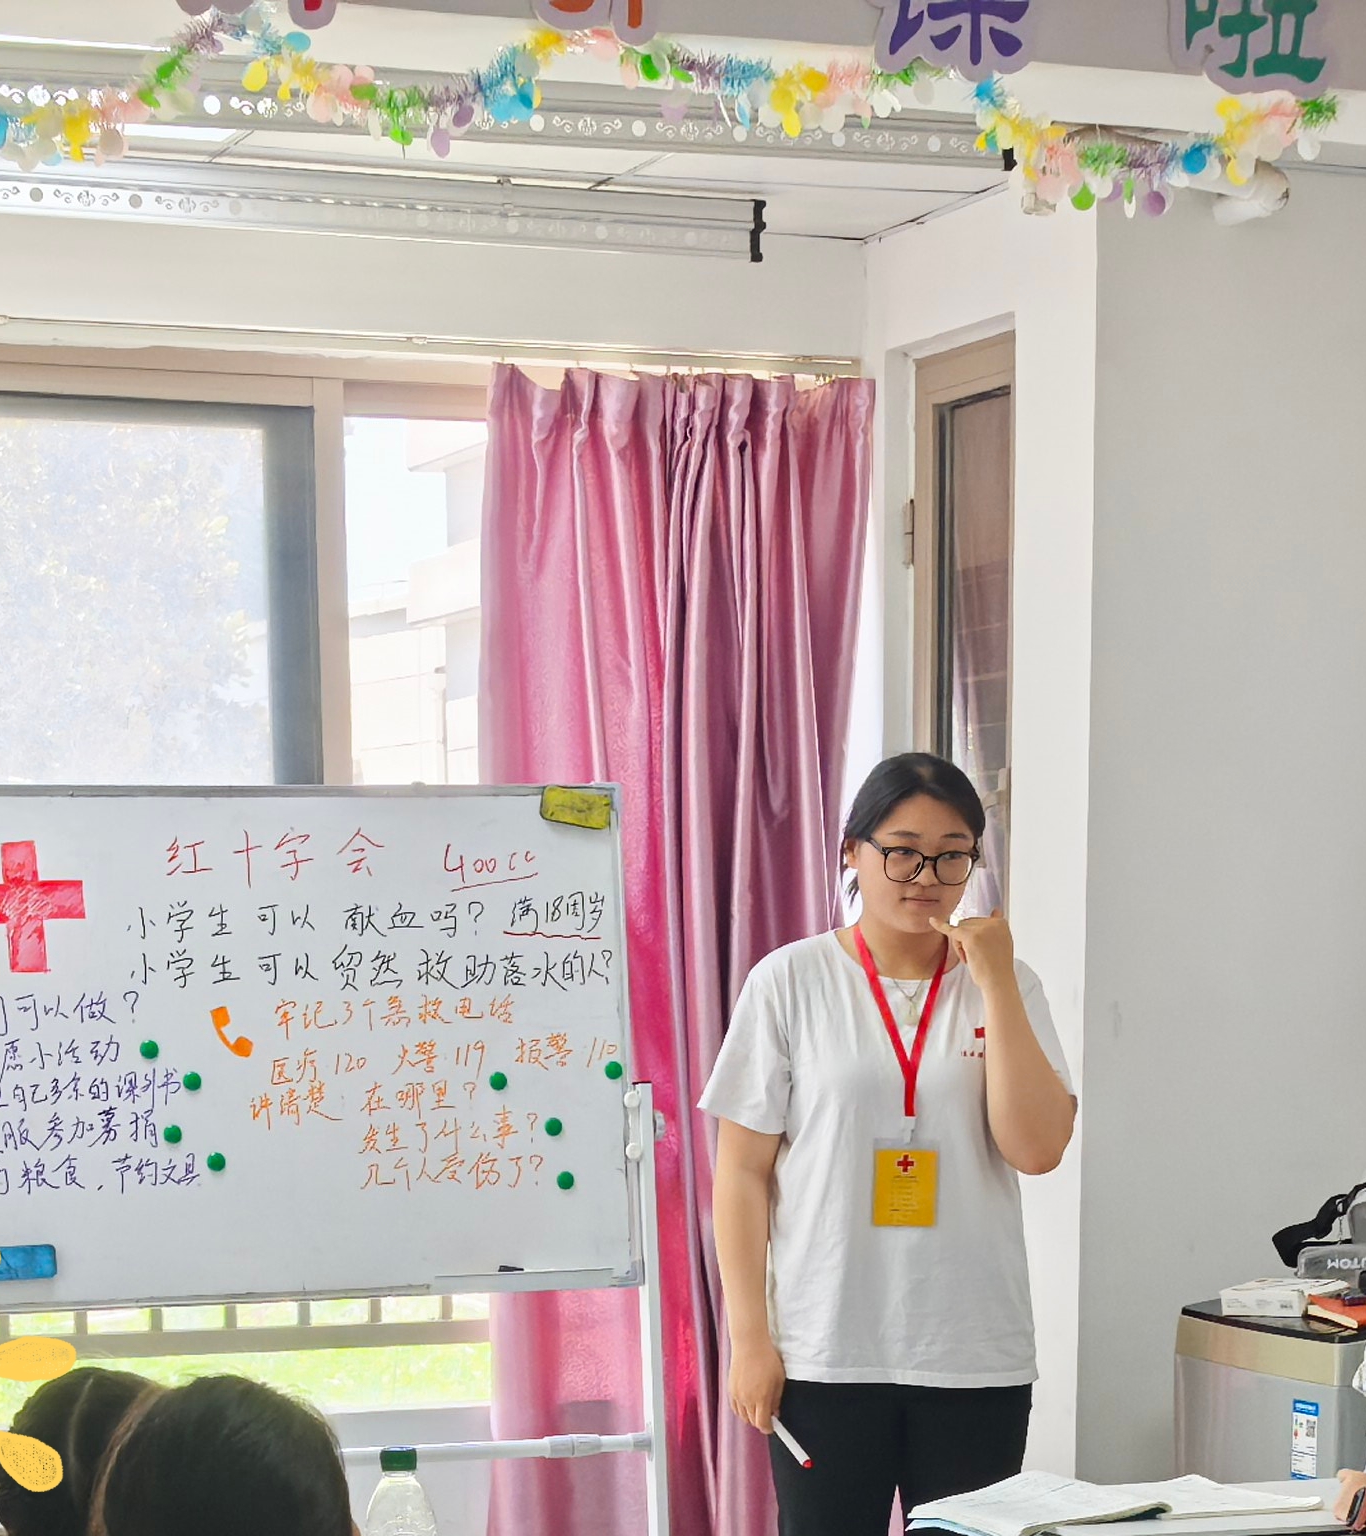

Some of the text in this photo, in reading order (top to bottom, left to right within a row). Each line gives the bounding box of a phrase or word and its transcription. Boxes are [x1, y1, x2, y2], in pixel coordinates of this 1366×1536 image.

[166, 827, 385, 888] 红十字会
[510, 891, 606, 933] 满18周岁
